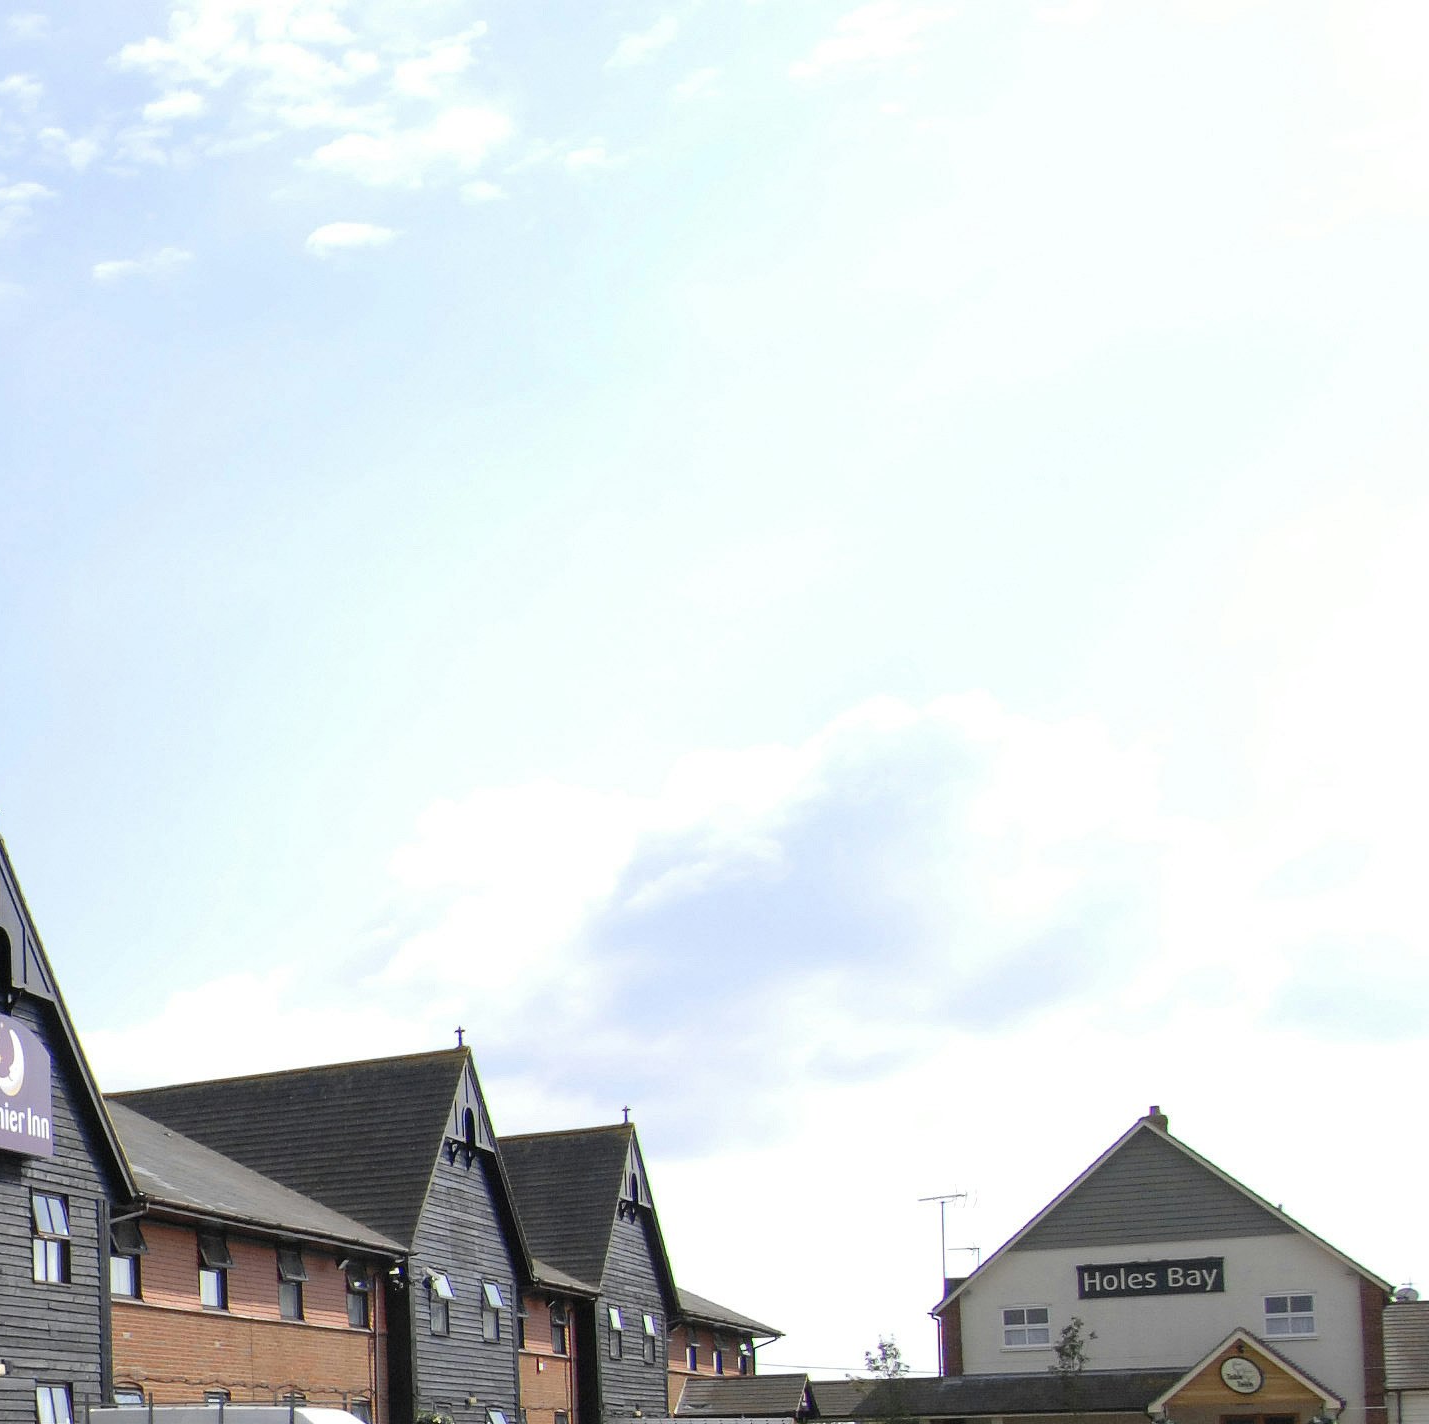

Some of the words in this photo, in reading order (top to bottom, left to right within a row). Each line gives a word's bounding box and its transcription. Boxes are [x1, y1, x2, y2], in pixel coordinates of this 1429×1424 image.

[27, 1107, 49, 1140] Inn
[1083, 1268, 1157, 1292] Holes
[1167, 1267, 1218, 1291] Bay
